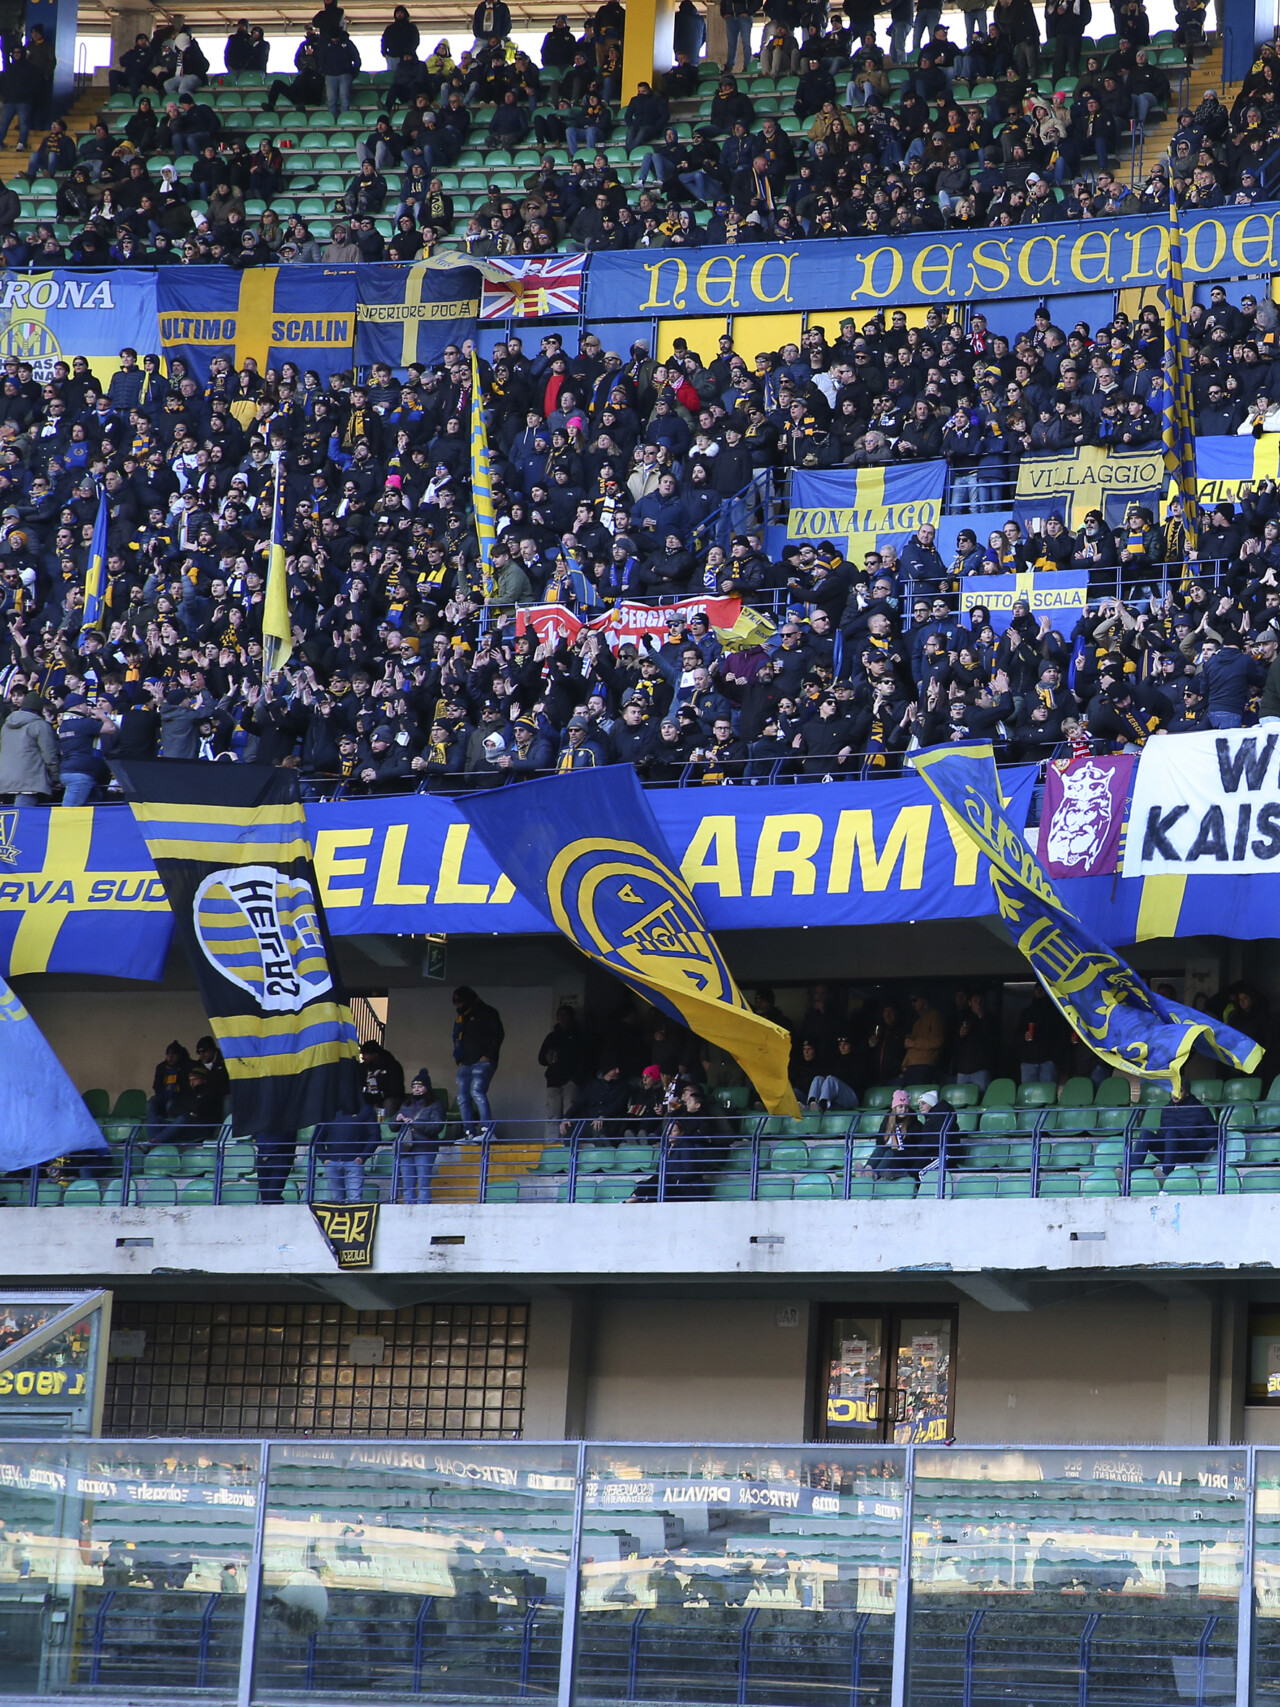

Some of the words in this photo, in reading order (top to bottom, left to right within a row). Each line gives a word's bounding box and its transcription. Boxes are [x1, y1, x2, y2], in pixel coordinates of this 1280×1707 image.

[0, 280, 115, 309] RONA
[161, 318, 236, 341] ULTIMO
[271, 319, 348, 342] SCALIN
[1030, 464, 1156, 487] VILLAGGIO
[965, 594, 1013, 609] SOTTO
[1033, 591, 1082, 607] SCALA
[680, 797, 1012, 899] ARMY
[88, 879, 169, 902] SUD
